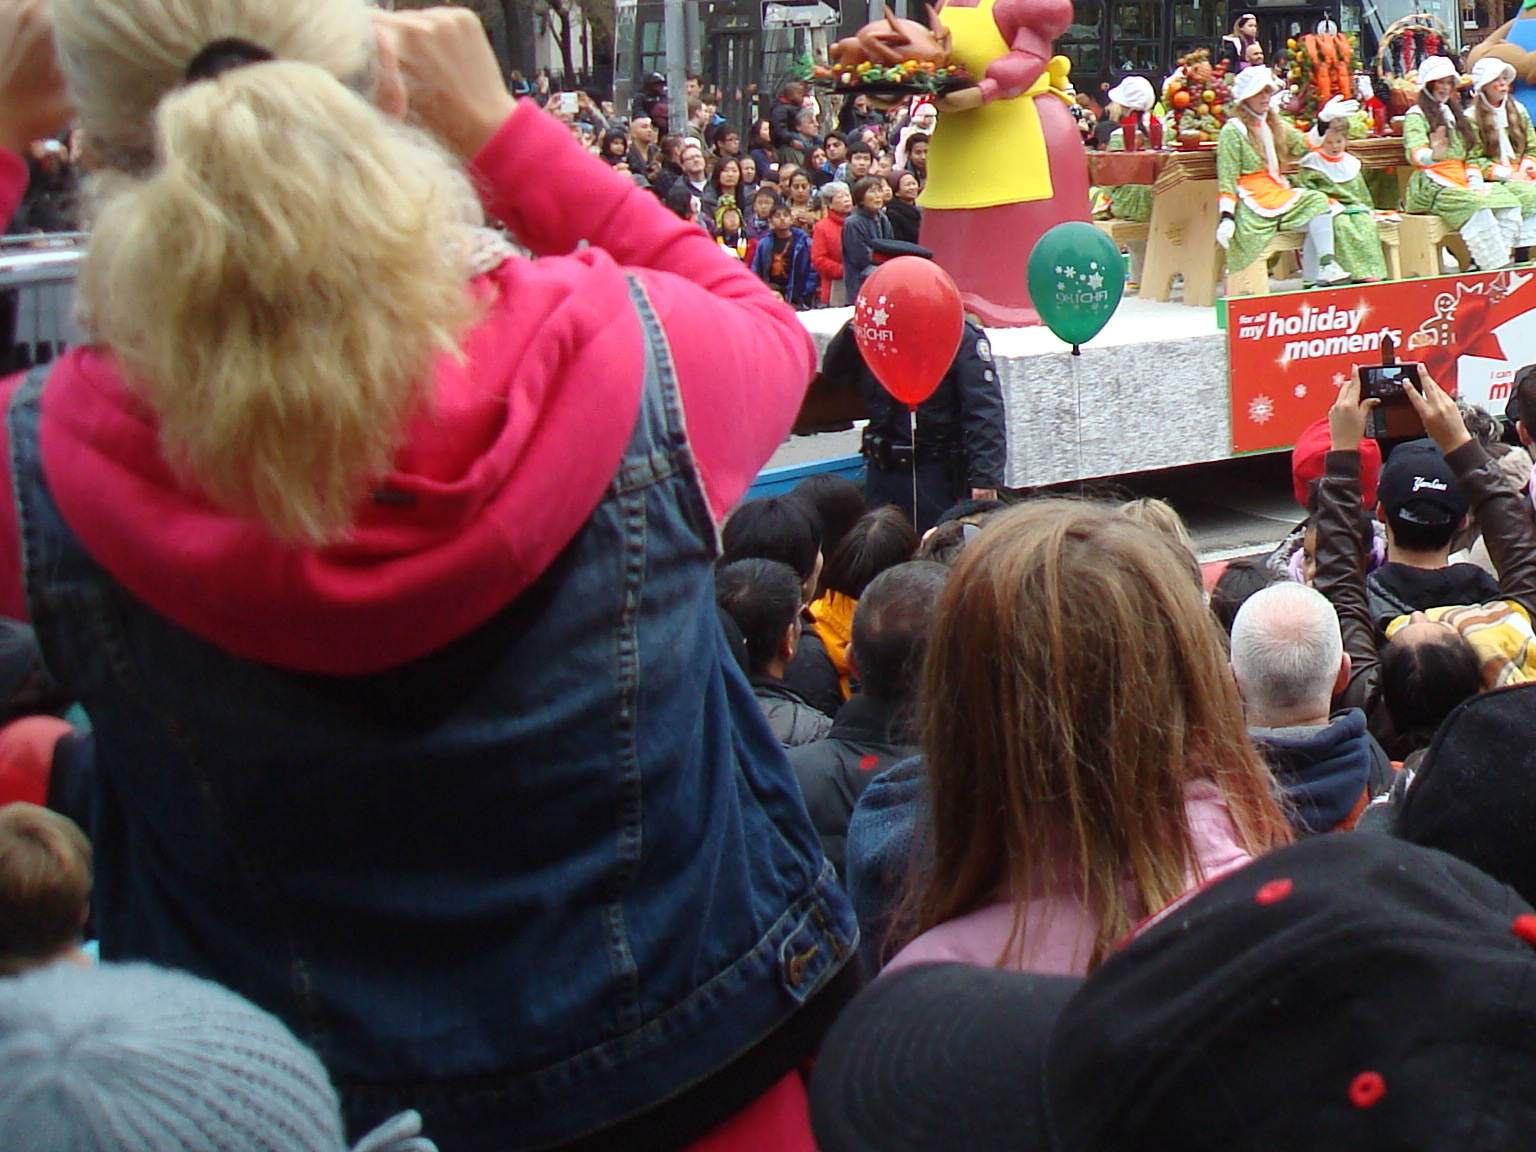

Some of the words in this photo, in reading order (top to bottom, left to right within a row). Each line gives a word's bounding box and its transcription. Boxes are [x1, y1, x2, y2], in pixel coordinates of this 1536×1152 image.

[1239, 314, 1253, 324] for
[1254, 313, 1267, 322] all
[1239, 325, 1265, 340] my
[1267, 305, 1364, 337] holiday
[1284, 327, 1402, 360] moments
[1489, 382, 1514, 400] m
